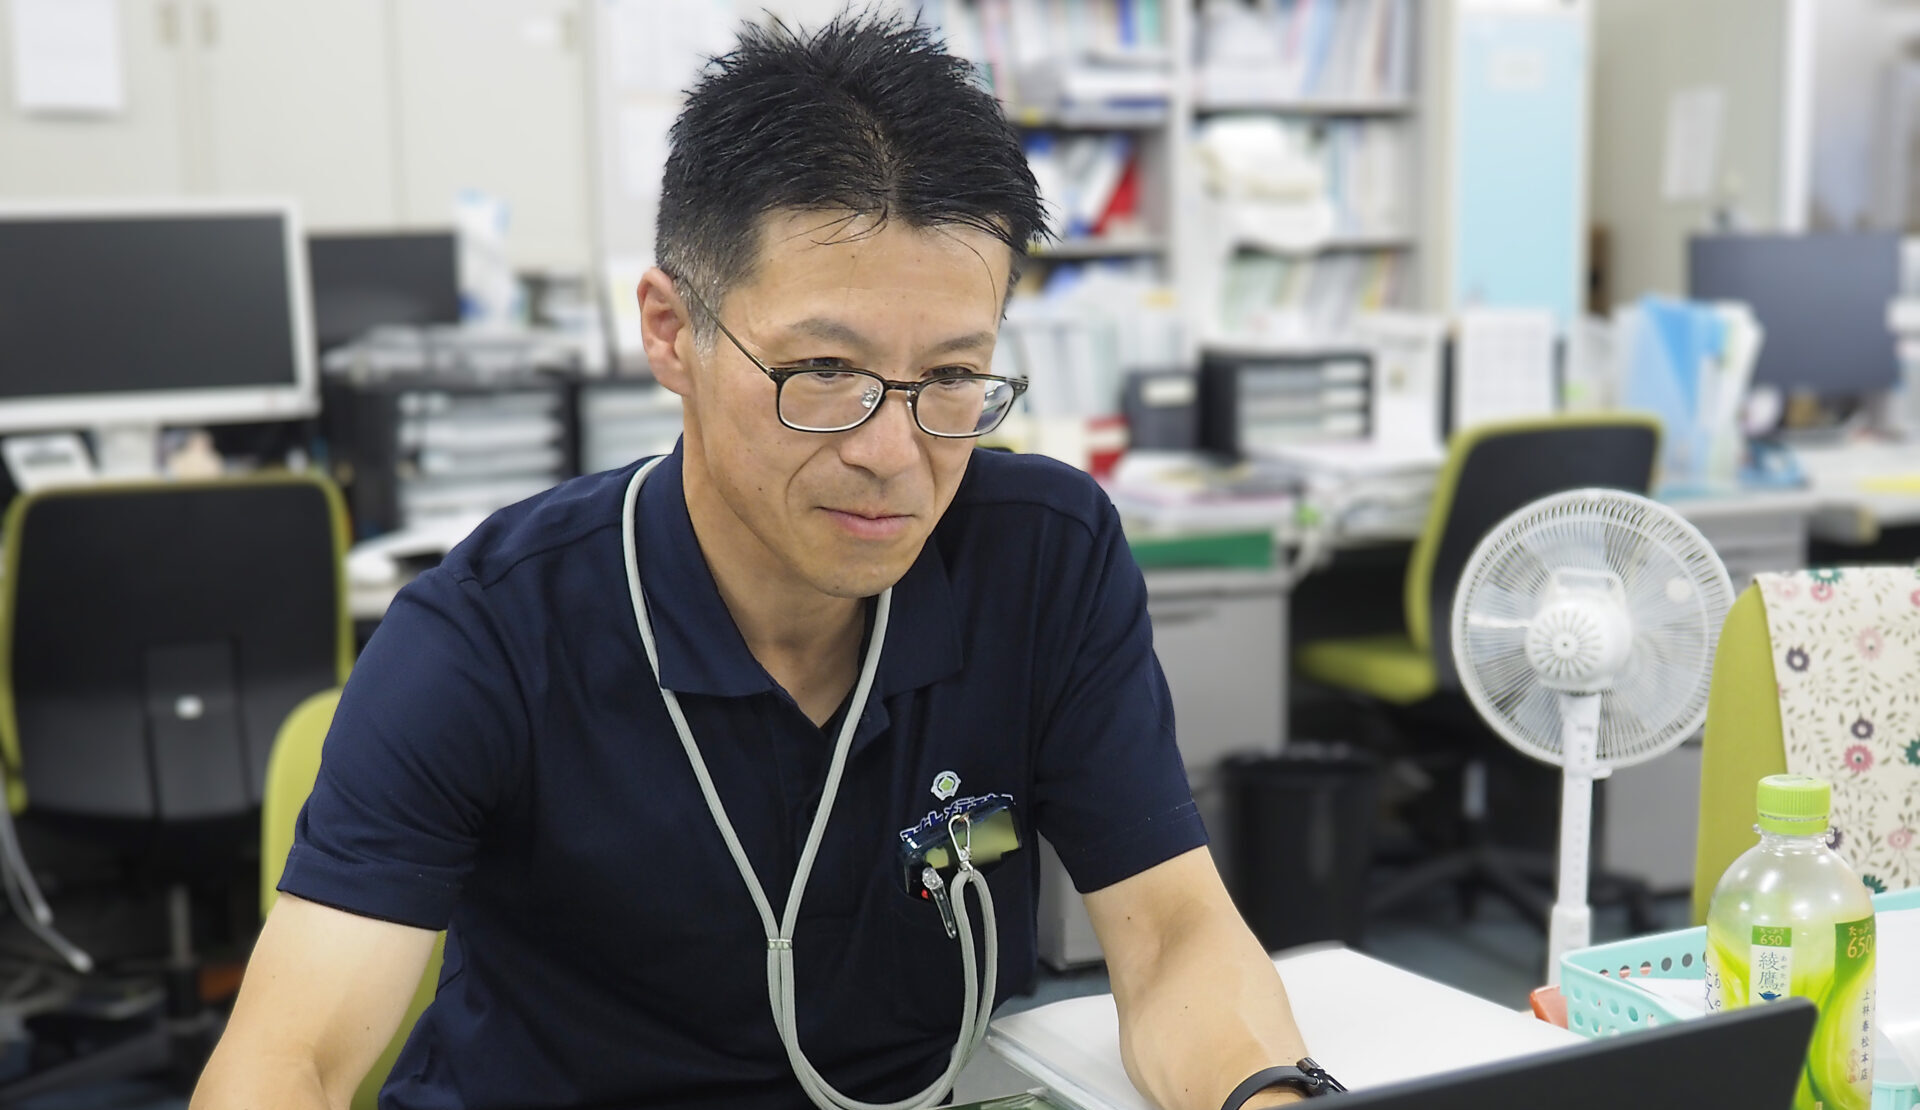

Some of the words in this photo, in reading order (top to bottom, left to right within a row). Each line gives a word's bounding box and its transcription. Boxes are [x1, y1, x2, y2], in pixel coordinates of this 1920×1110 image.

[1760, 934, 1783, 946] 650
[1847, 934, 1873, 959] 650
[1758, 951, 1780, 991] 綾鷹
[1860, 990, 1871, 1081] 上林春松本店
